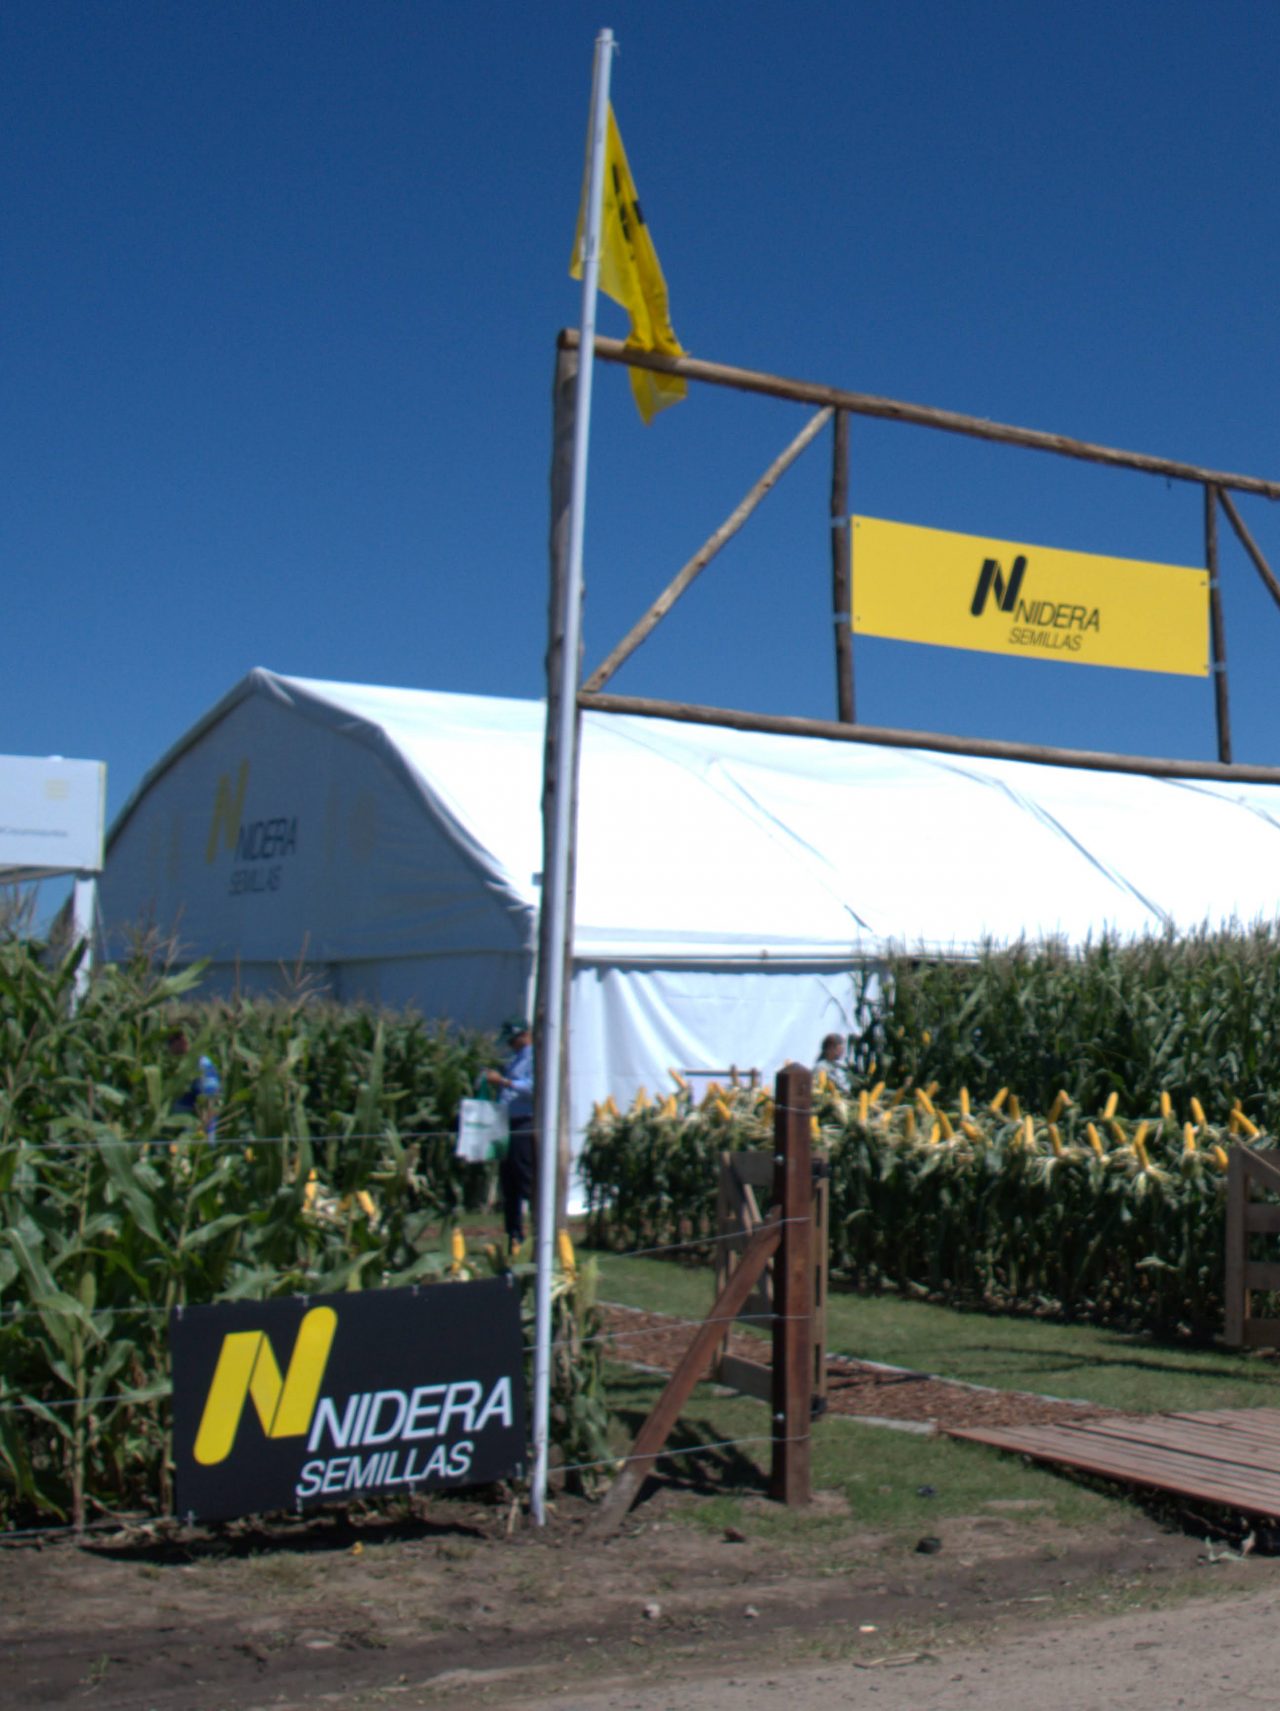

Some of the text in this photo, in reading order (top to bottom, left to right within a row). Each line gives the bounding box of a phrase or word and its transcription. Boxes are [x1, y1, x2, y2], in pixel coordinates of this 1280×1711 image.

[1013, 600, 1101, 633] NIDERA
[1008, 627, 1083, 652] SEMILLAS
[307, 1376, 513, 1454] NIDERA
[296, 1440, 475, 1498] SEMILLAS
